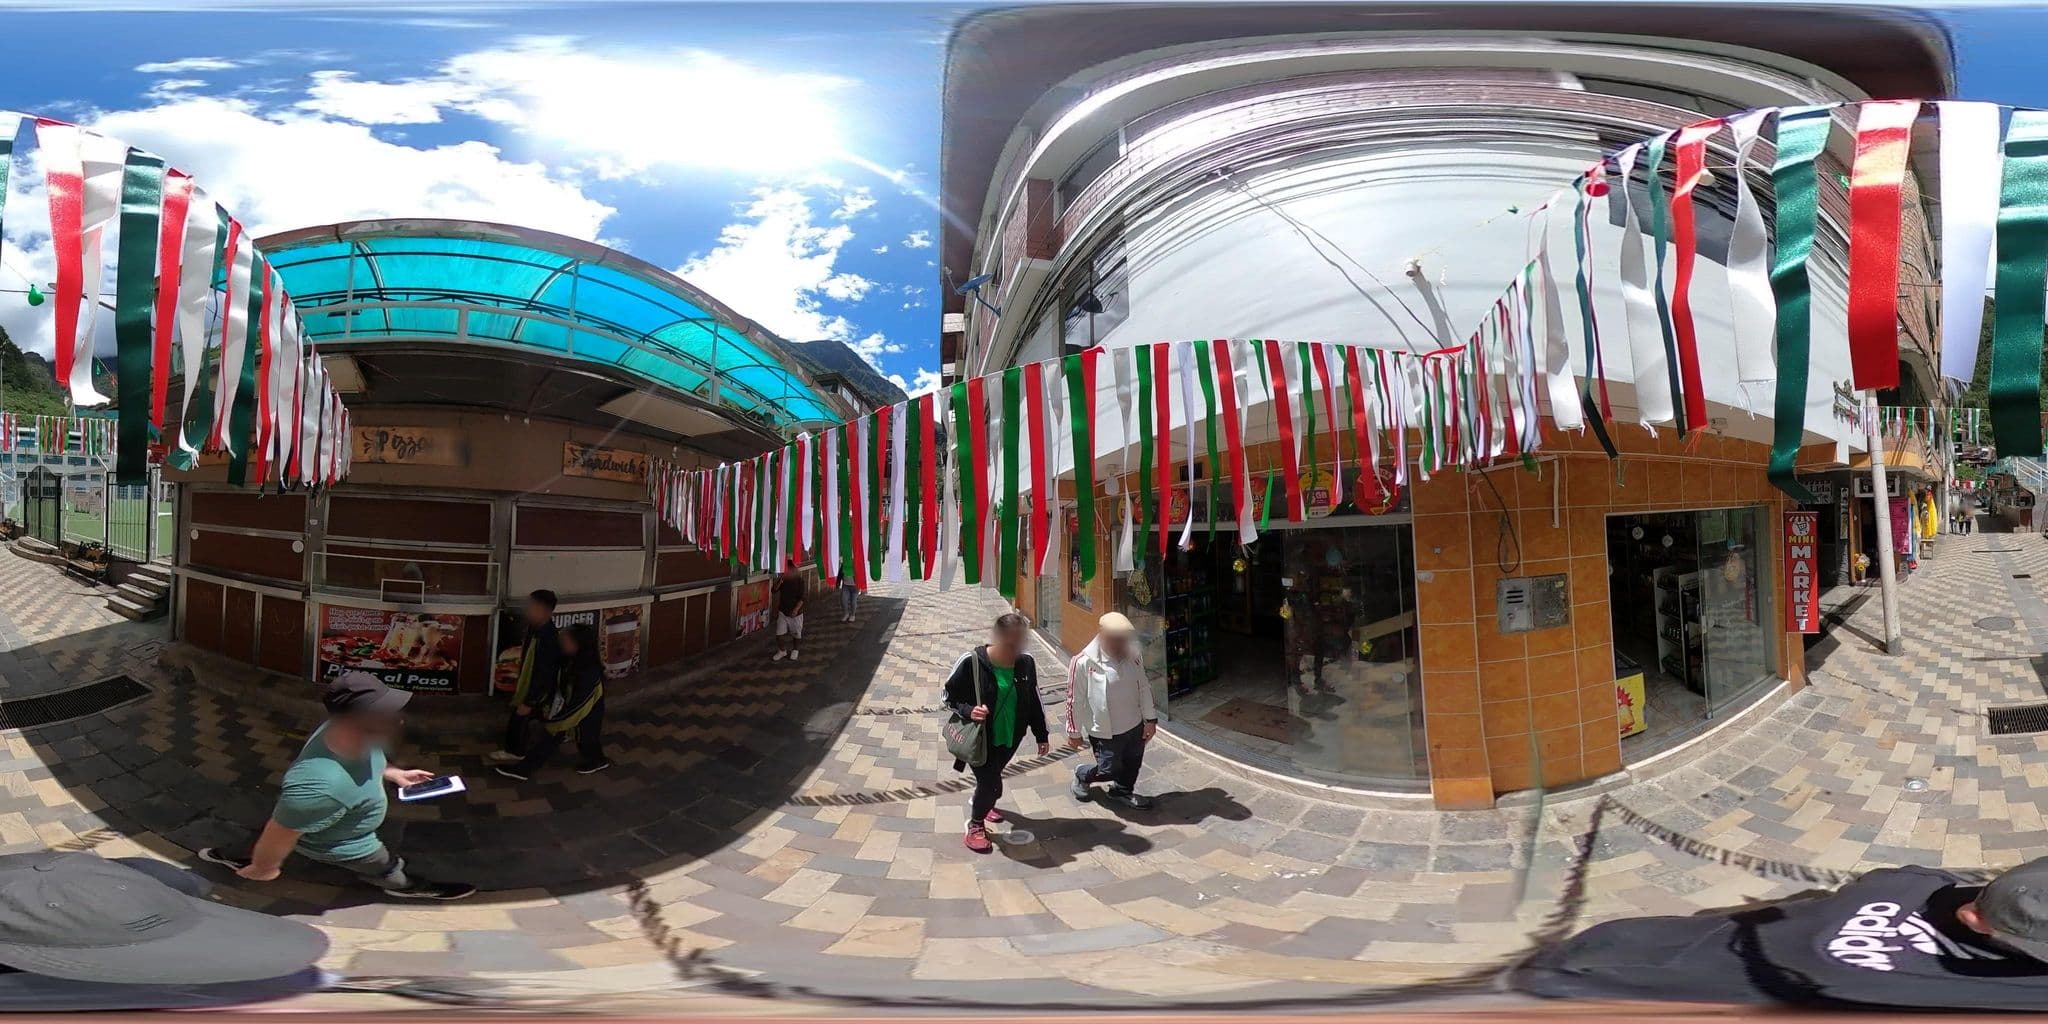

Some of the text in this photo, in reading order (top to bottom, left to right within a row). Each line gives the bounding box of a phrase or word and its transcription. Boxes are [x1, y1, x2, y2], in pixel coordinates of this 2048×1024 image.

[1788, 535, 1814, 544] MINI
[1791, 545, 1812, 631] MARKET
[551, 612, 594, 629] URGER
[384, 673, 402, 684] al
[407, 674, 450, 686] Paso
